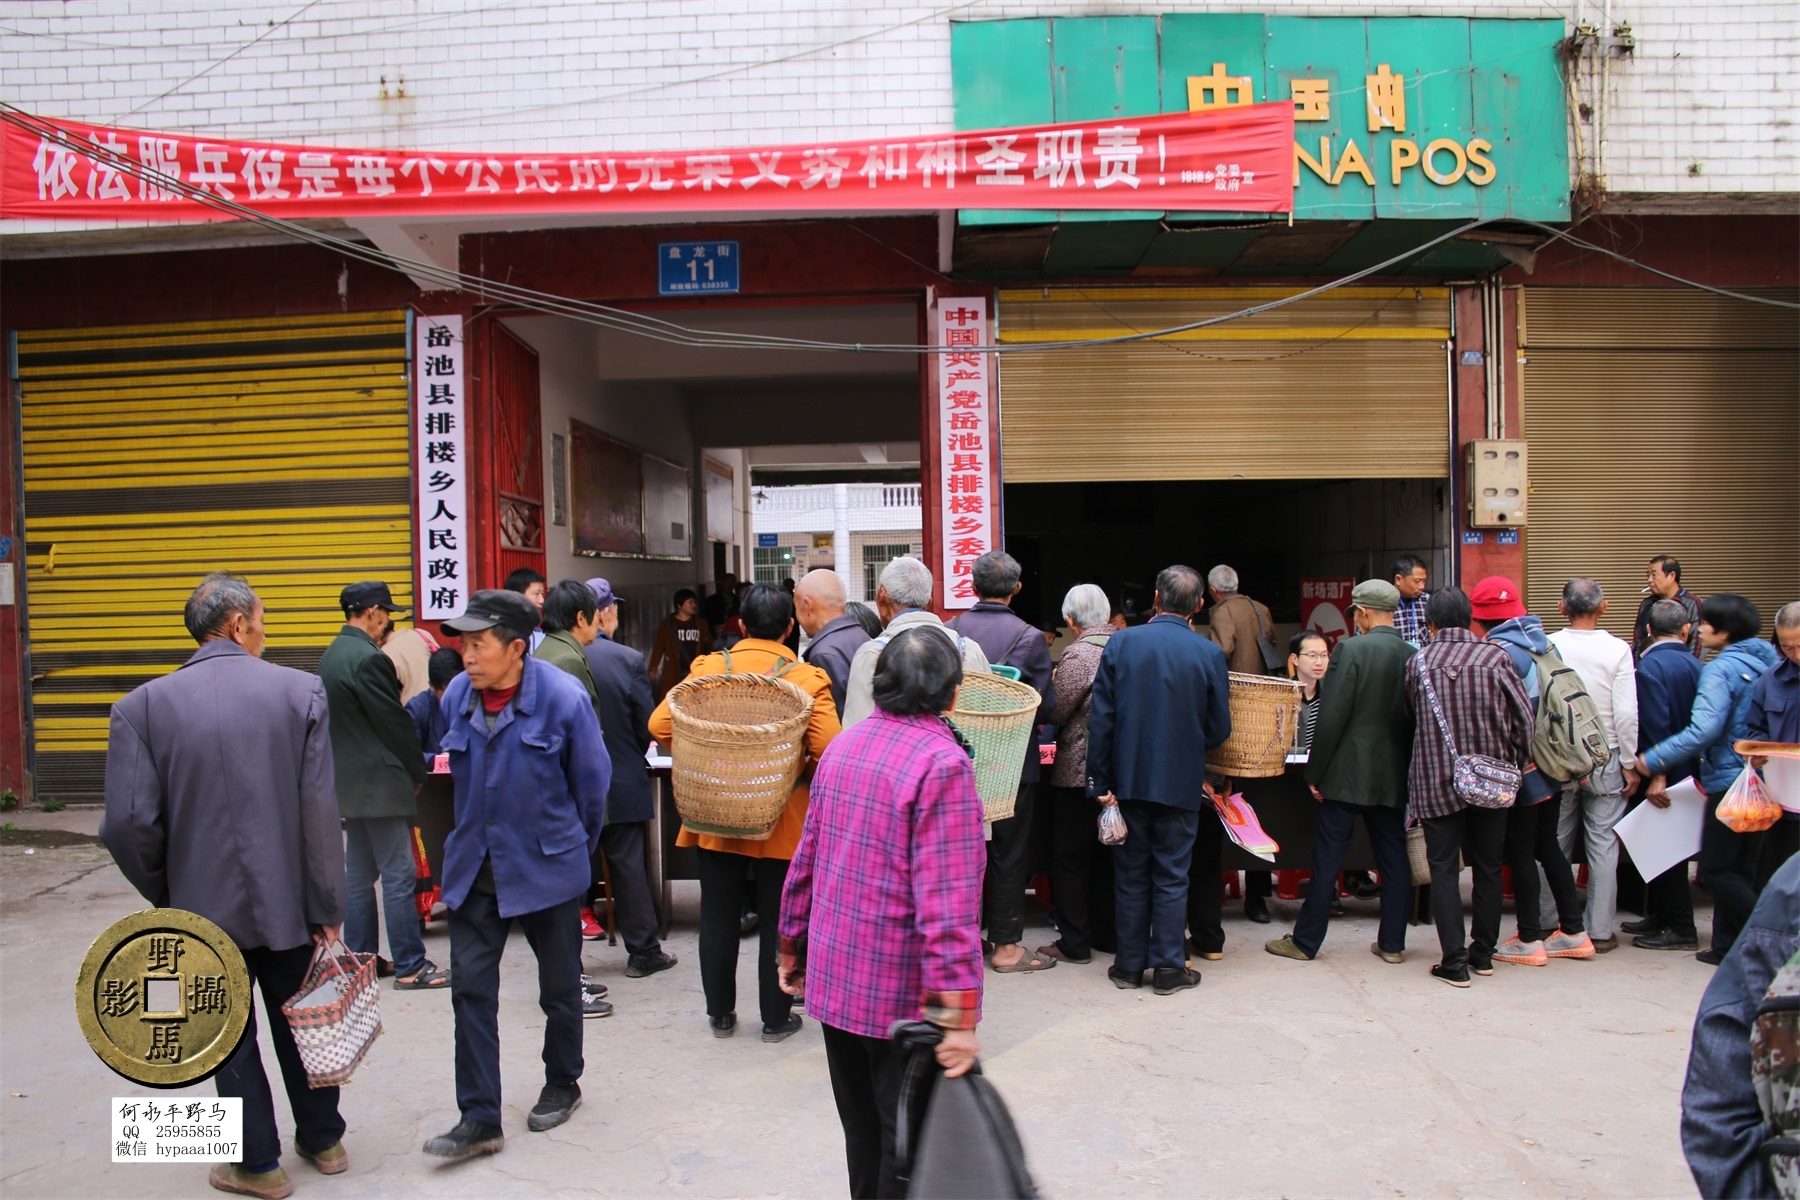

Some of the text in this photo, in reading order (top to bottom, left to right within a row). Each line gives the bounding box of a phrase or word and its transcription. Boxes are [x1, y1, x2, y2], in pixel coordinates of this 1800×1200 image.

[1391, 137, 1497, 186] POS
[686, 259, 714, 281] 11
[424, 325, 460, 609] 岳池县排楼乡人民政府
[945, 307, 984, 599] 中国共产党岳池县排楼乡委员会
[1303, 582, 1351, 599] 新场酒厂
